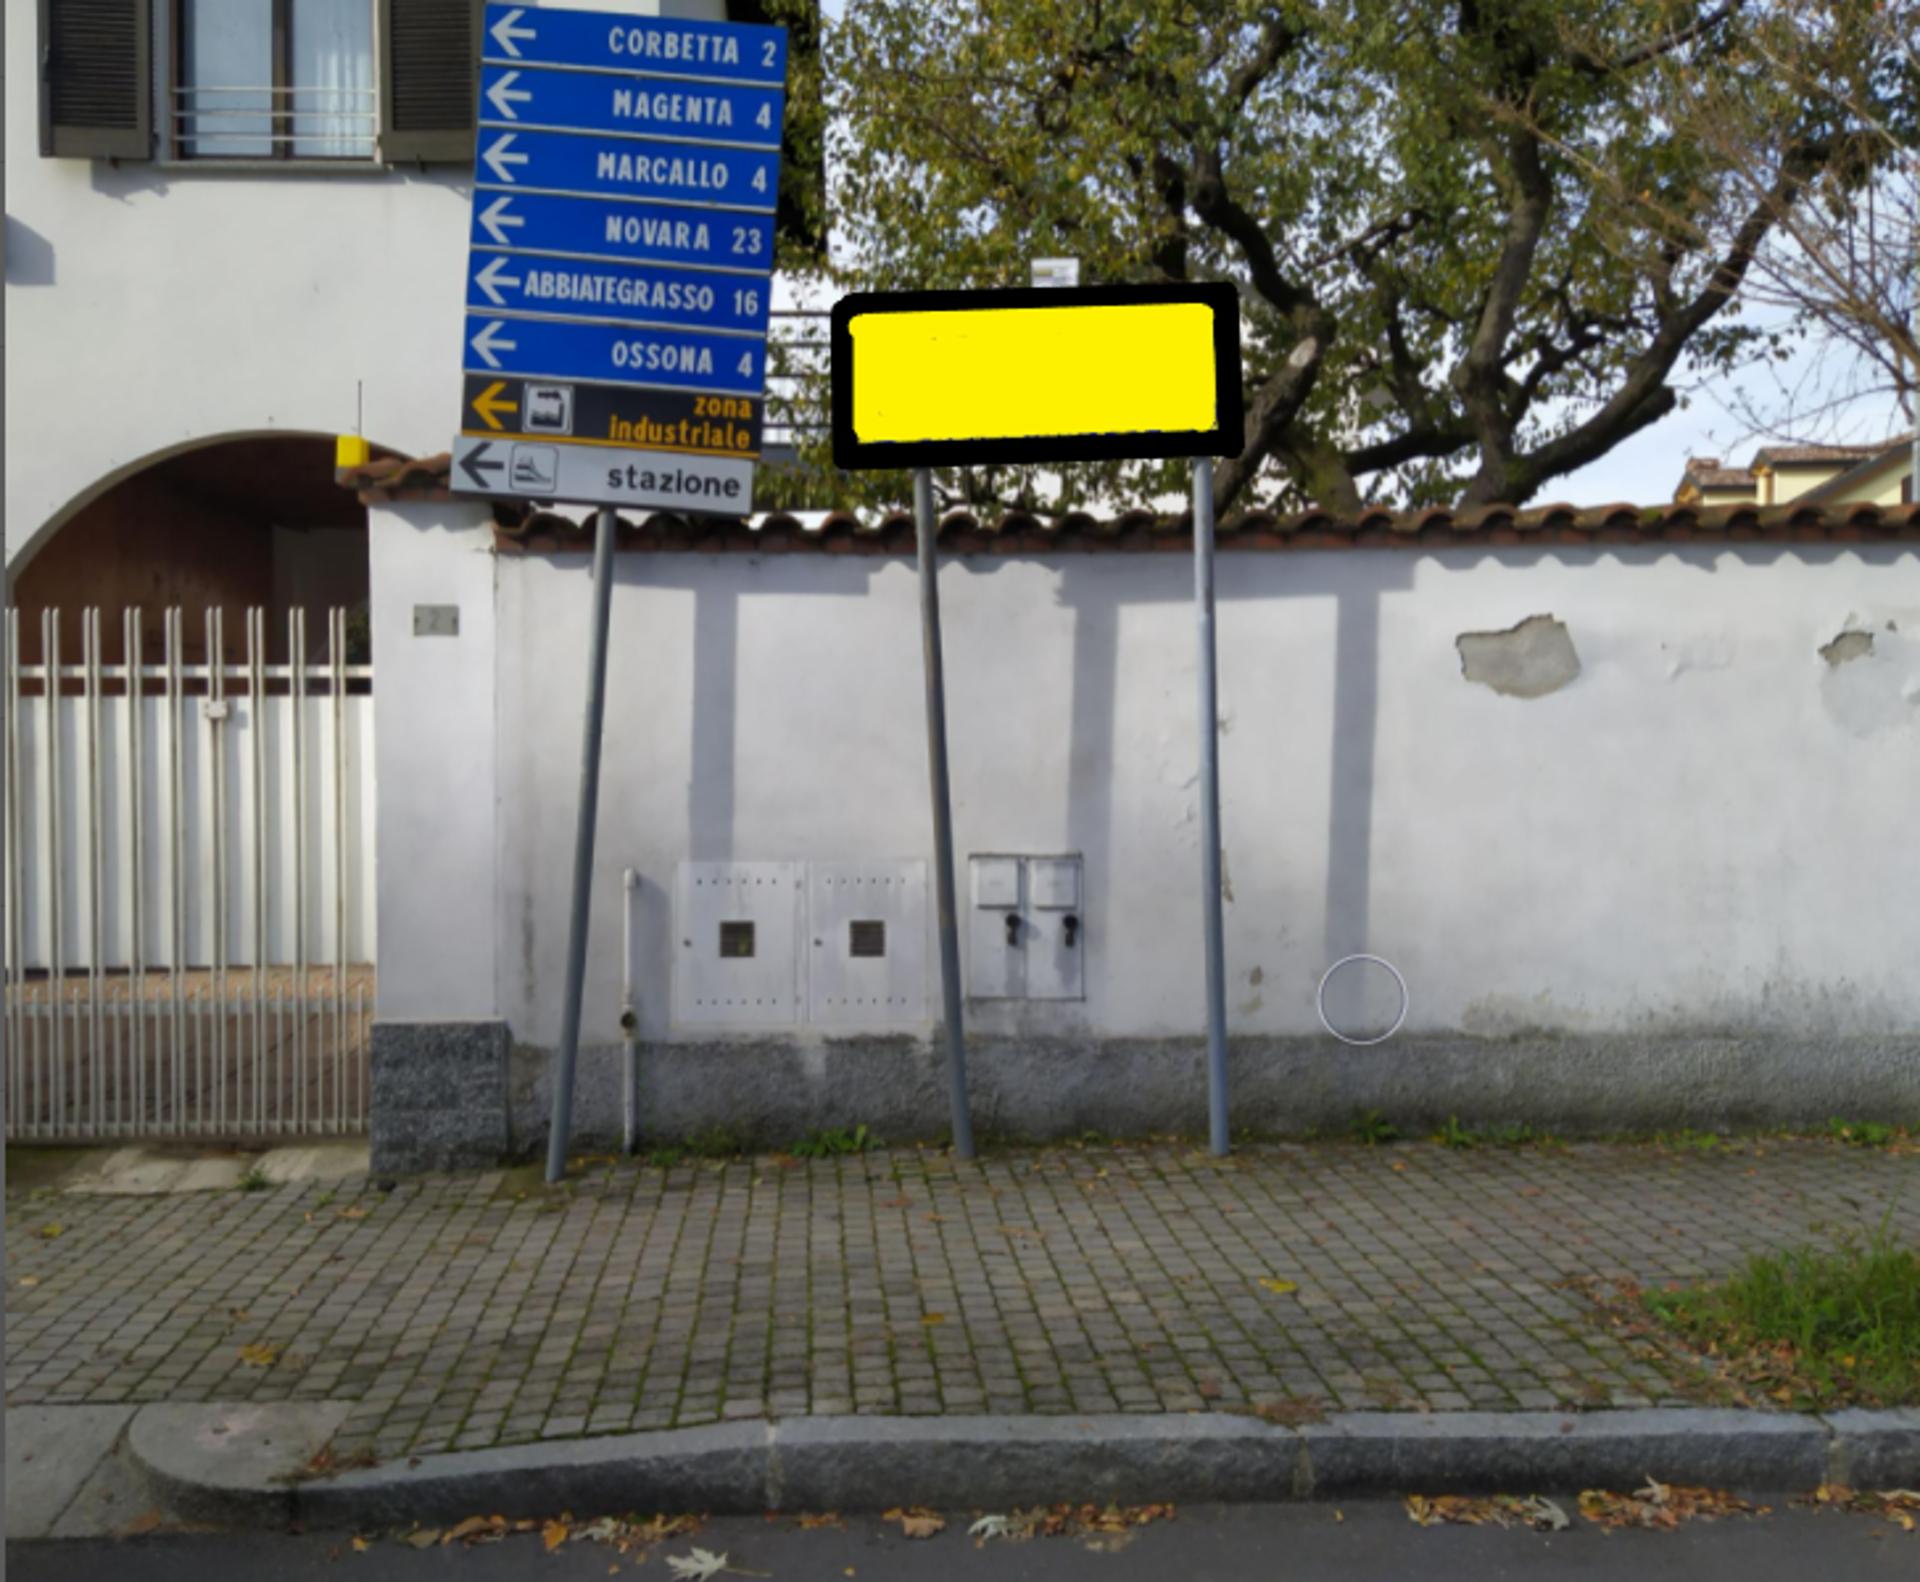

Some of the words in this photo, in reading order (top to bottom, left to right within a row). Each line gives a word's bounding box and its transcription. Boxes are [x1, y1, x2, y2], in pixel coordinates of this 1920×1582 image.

[608, 26, 739, 65] CORBETTA
[761, 41, 777, 67] 2
[612, 89, 734, 127] MAGENTA
[756, 104, 772, 130] 4
[596, 152, 729, 190] MARCALLO
[751, 166, 767, 192] 4
[605, 215, 710, 251] NOVARA
[732, 228, 762, 254] 23
[523, 270, 714, 312] ABBIATEGRASSO
[734, 289, 759, 317] 16
[611, 340, 713, 375] OSSONA
[737, 352, 753, 378] 4
[694, 396, 752, 419] zona
[608, 415, 750, 450] industriale
[607, 464, 741, 498] stazione
